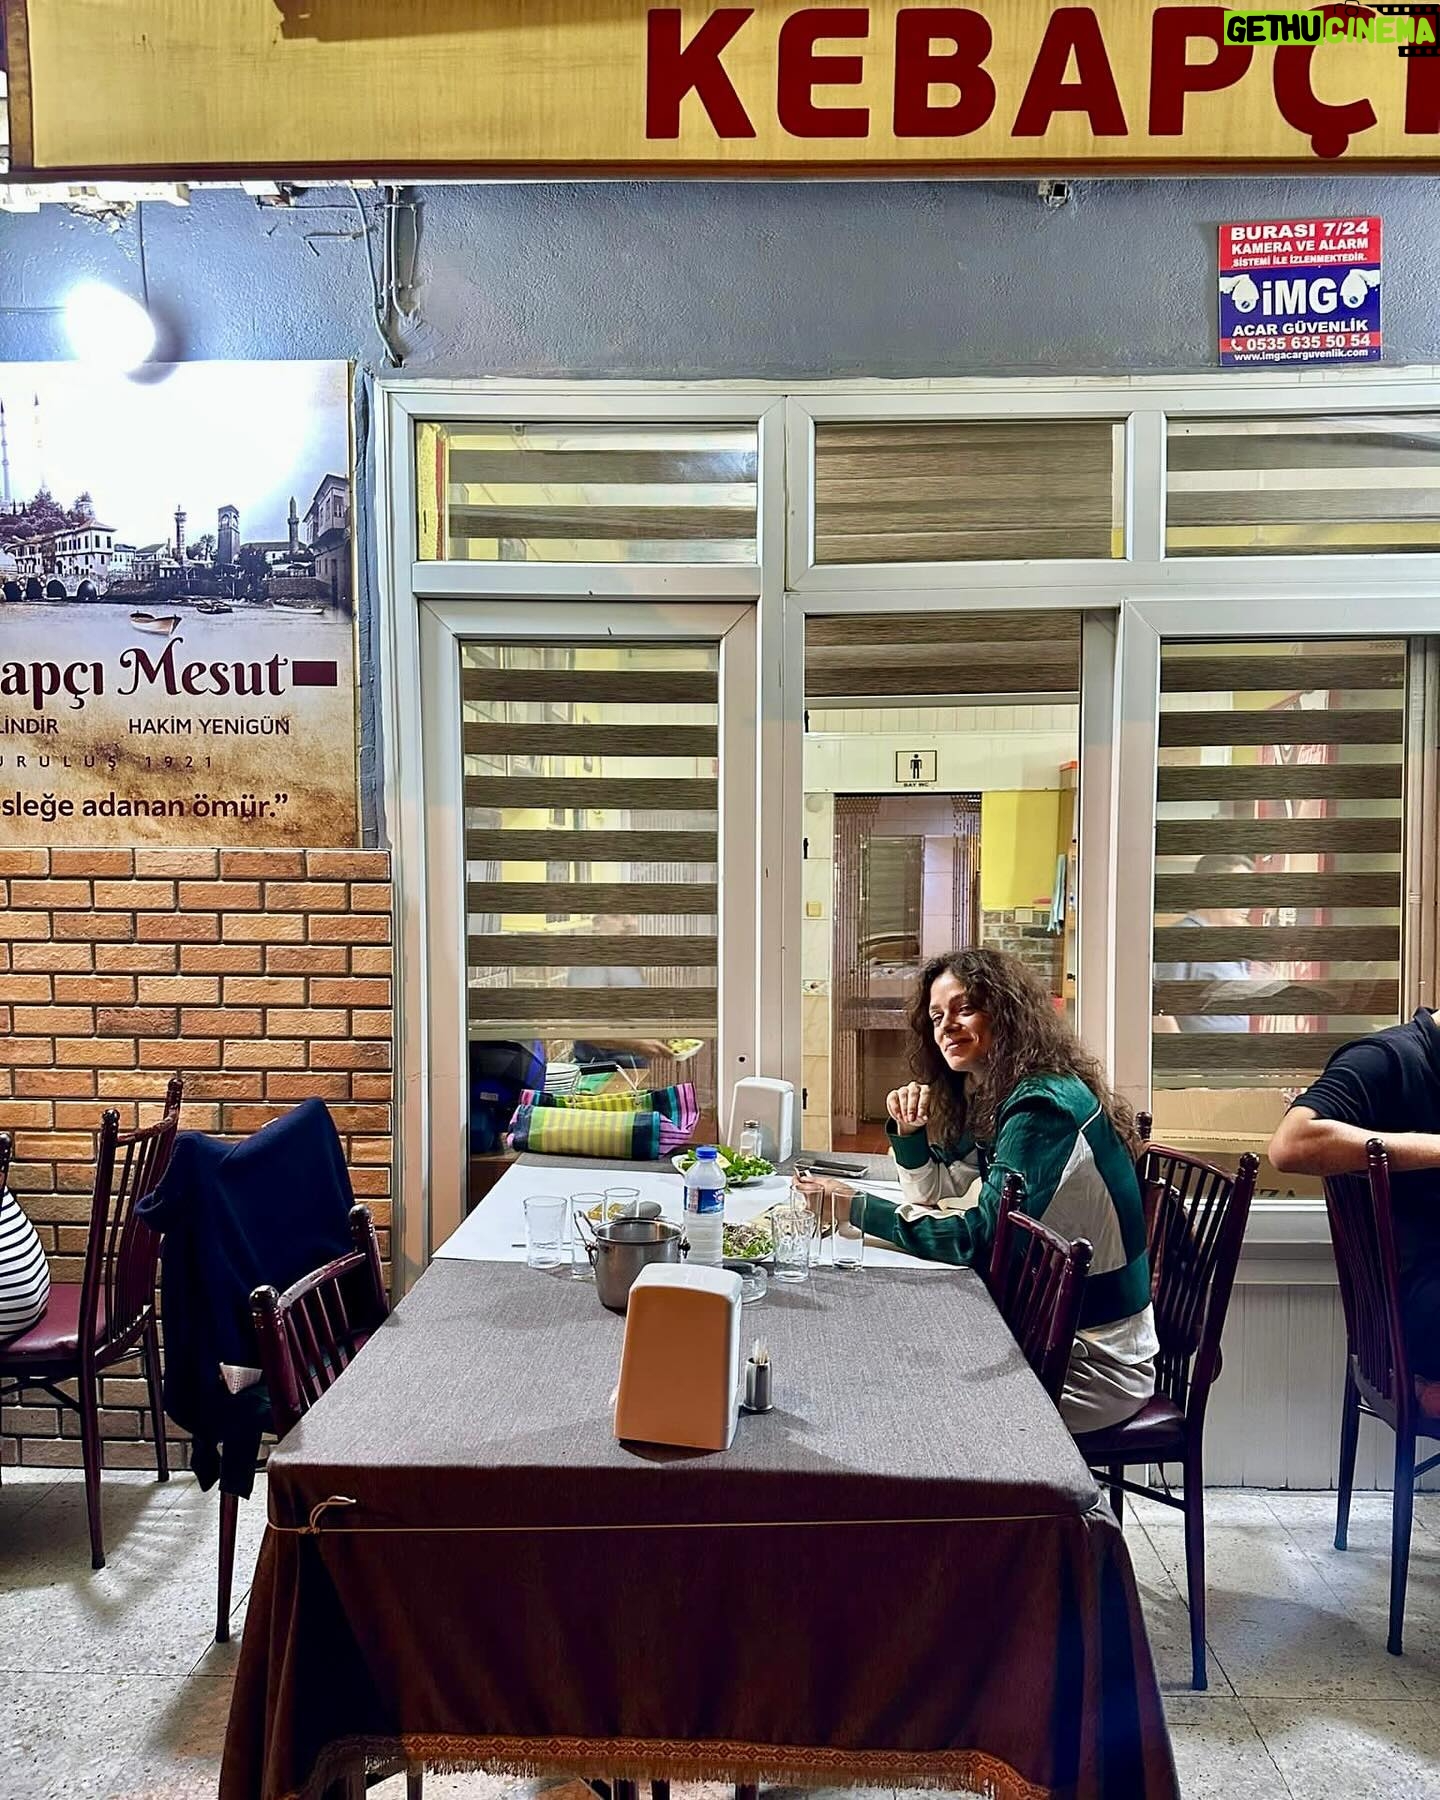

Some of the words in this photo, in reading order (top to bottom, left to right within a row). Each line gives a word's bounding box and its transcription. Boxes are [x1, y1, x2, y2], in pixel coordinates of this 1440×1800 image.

[1231, 223, 1316, 241] BURASI
[1322, 221, 1370, 236] 7/24
[1231, 242, 1293, 256] KAMERA
[1297, 241, 1315, 252] VE
[1318, 238, 1369, 251] ALARM
[1232, 257, 1271, 267] SİSTEMİ
[1273, 256, 1288, 265] İLE
[1232, 323, 1279, 337] ACAR
[1282, 317, 1369, 334] GÜVENLİK
[1246, 339, 1286, 351] 0535
[1291, 338, 1321, 349] 635
[1326, 337, 1346, 348] 50
[1350, 335, 1371, 347] 54
[1234, 348, 1369, 362] www.imgacarguvenlik.com
[117, 637, 288, 696] Mesut
[129, 715, 192, 735] HAKİM
[198, 715, 290, 735] YENİGÜN
[145, 755, 213, 768] 1921
[83, 791, 185, 817] adanan
